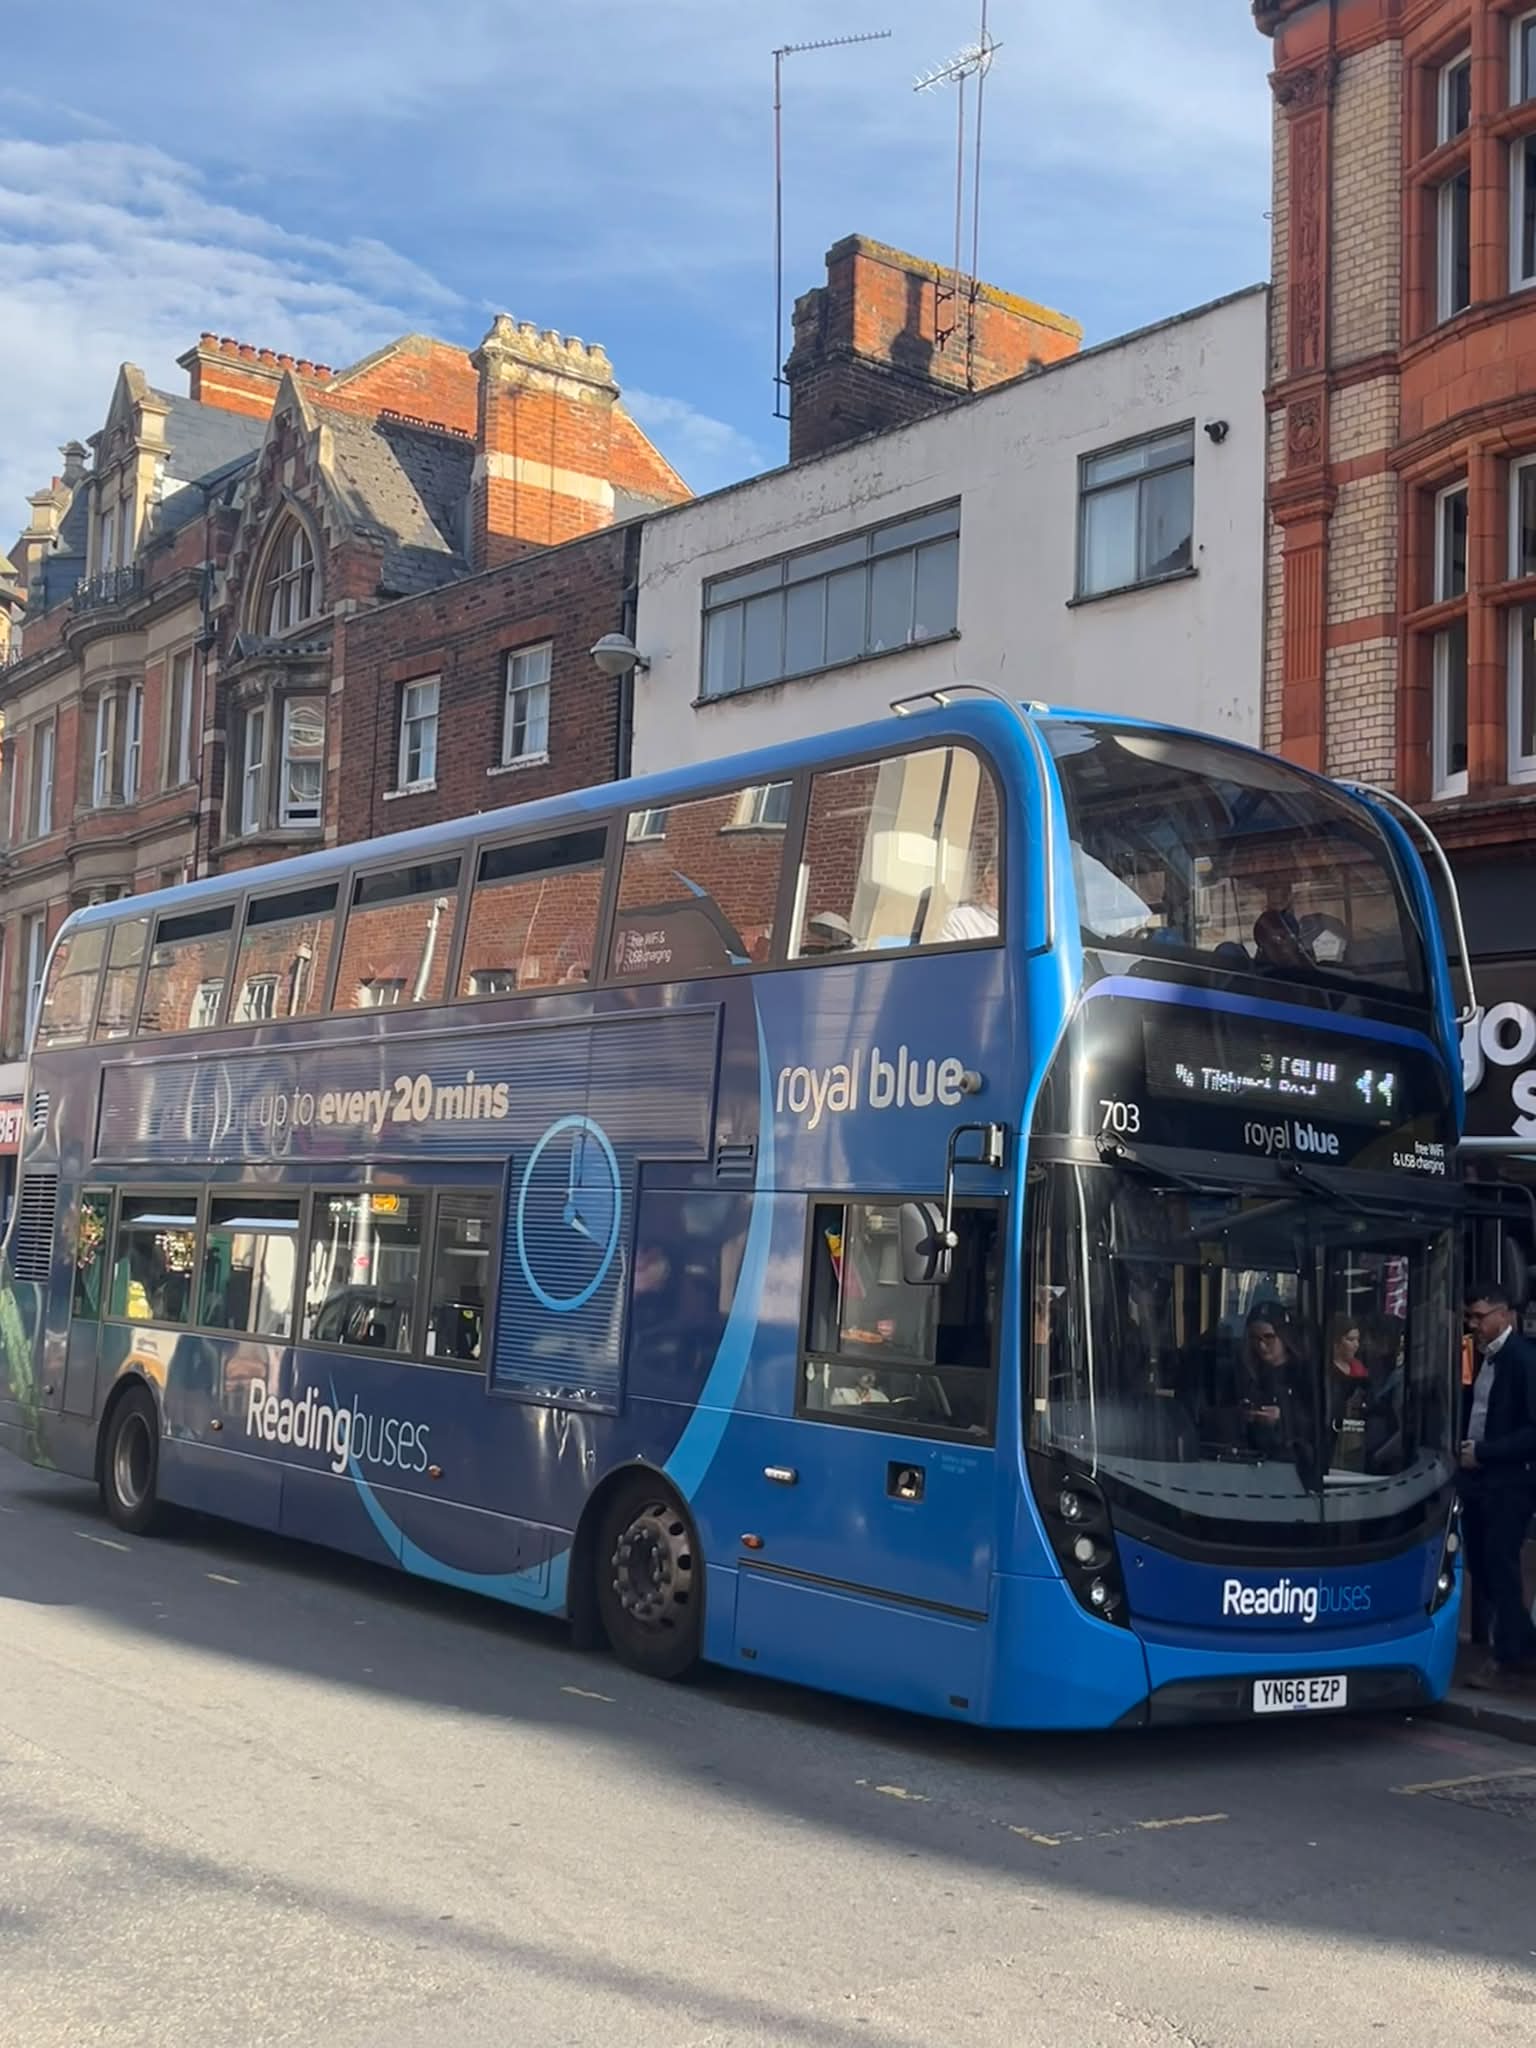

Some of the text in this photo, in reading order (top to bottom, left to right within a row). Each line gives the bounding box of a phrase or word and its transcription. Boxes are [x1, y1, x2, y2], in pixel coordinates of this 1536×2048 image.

[292, 1087, 315, 1126] to
[319, 1088, 392, 1135] every
[392, 1073, 433, 1123] 20
[434, 1069, 510, 1121] mins
[776, 1044, 965, 1130] royal blue
[1099, 1100, 1140, 1133] 703
[1244, 1120, 1340, 1157] royal blue
[1400, 1153, 1415, 1168] USB
[1416, 1156, 1445, 1176] charging
[1261, 1679, 1341, 1706] YN66 EZP
